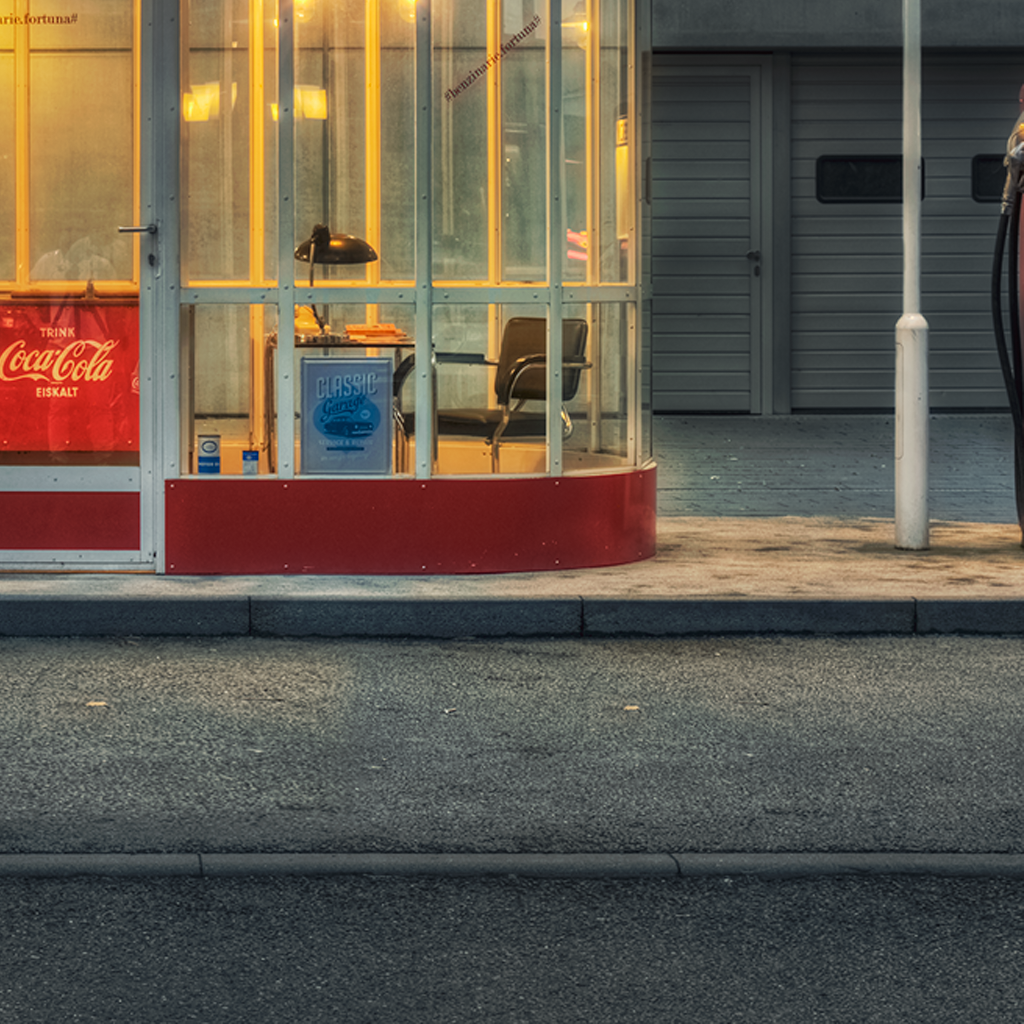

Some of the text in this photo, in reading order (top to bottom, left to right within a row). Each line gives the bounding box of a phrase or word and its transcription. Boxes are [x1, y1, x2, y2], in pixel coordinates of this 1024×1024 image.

[40, 327, 75, 337] TRINK
[36, 387, 78, 398] EISKALT
[317, 372, 378, 399] CLASSIC
[320, 394, 366, 423] Garage
